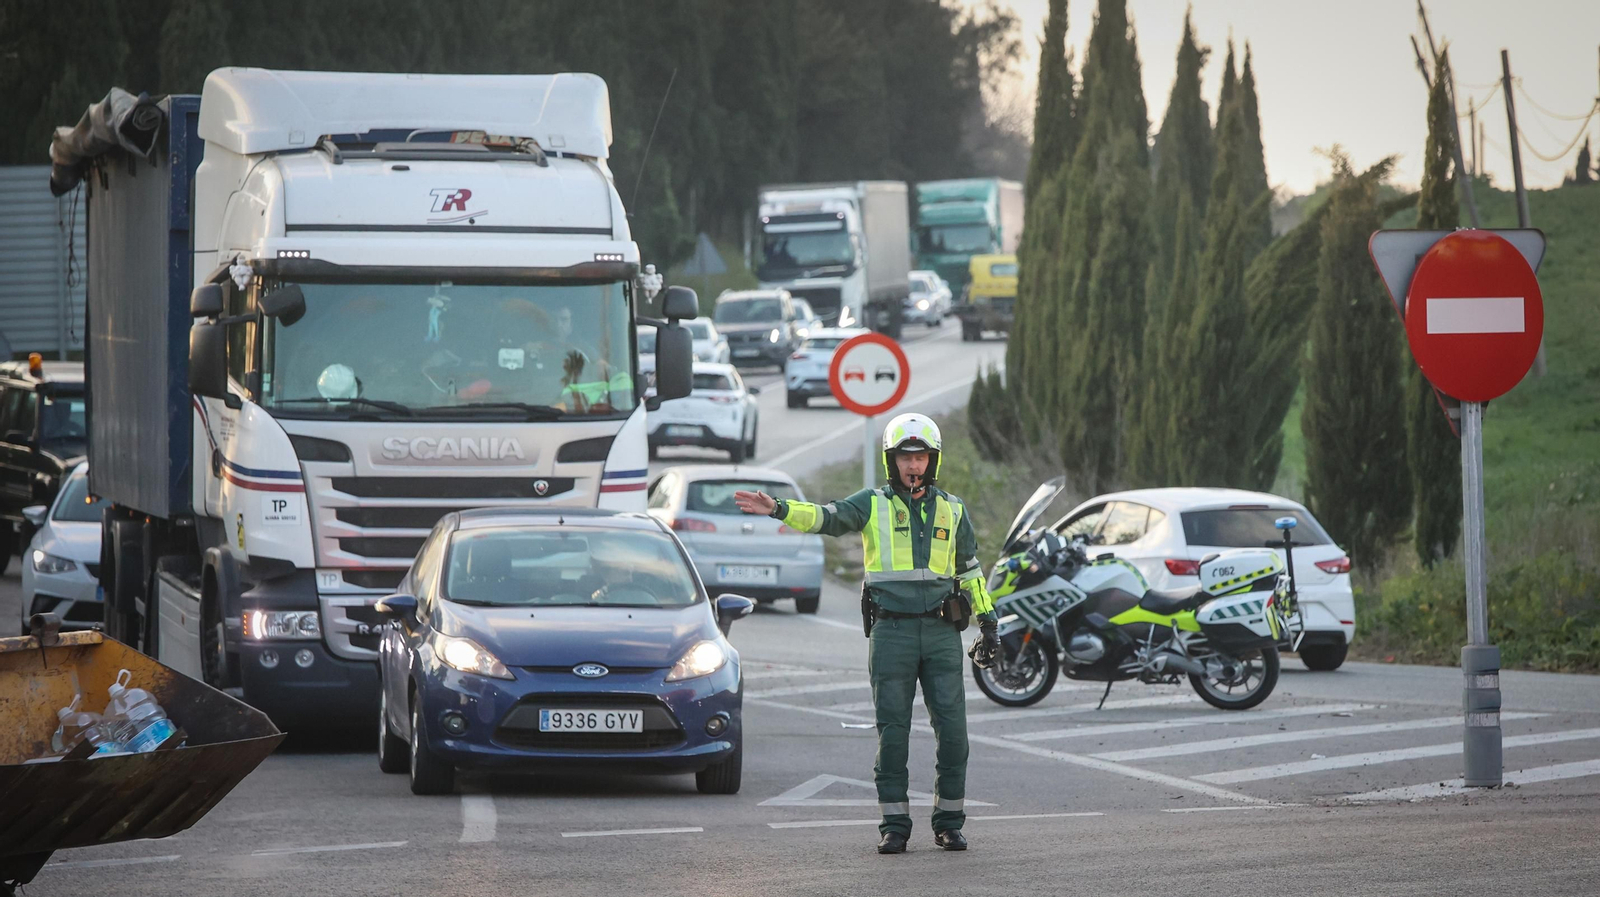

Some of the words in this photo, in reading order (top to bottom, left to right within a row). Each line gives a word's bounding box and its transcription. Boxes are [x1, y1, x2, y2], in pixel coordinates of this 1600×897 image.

[430, 188, 472, 212] TR
[382, 436, 526, 460] SCANIA
[272, 500, 287, 513] TP
[1219, 566, 1235, 577] 062
[321, 573, 338, 586] TP
[359, 624, 370, 635] R
[580, 666, 601, 675] Ford
[552, 712, 597, 729] 9336
[605, 713, 638, 729] GYV
